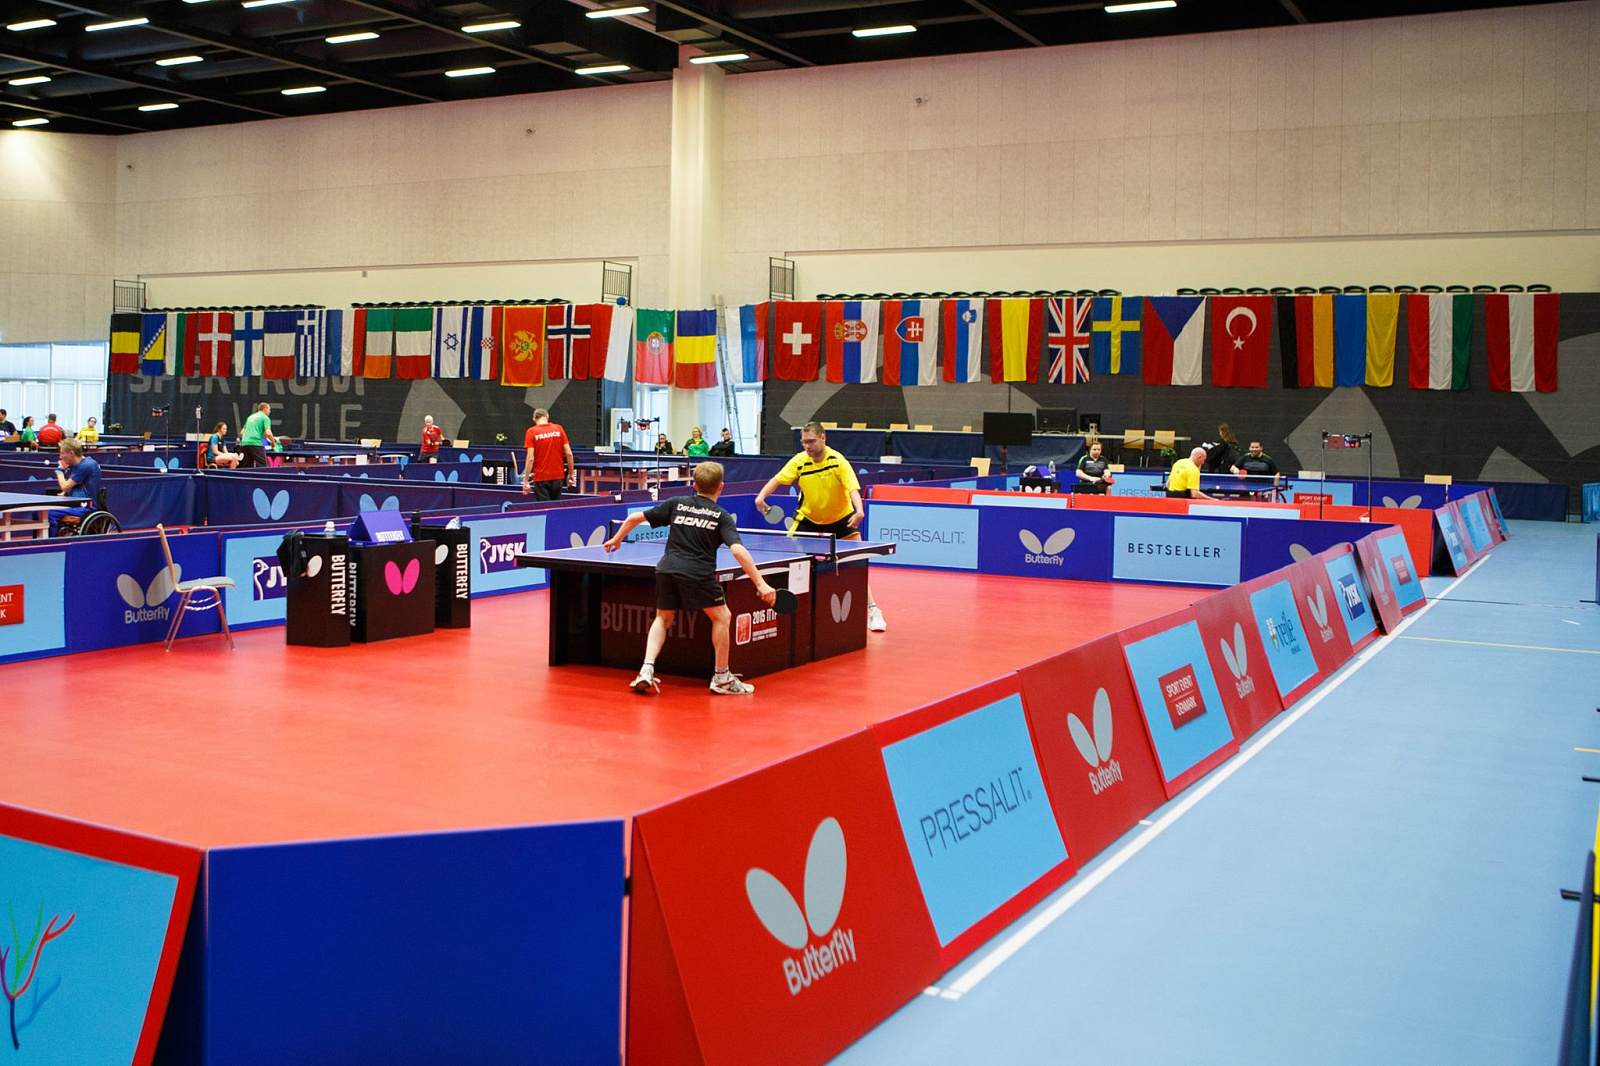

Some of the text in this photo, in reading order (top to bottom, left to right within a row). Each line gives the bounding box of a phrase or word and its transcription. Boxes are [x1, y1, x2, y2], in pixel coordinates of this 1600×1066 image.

[535, 431, 561, 441] FRANCE
[677, 503, 721, 519] Deutschland
[674, 516, 719, 530] DONIC
[1127, 542, 1221, 558] BESTSELLER
[1024, 553, 1065, 566] Butterfly
[455, 543, 468, 599] BUTTERFLY
[331, 554, 346, 615] BUTTERFLY
[124, 606, 170, 624] Butterfly
[1088, 759, 1123, 796] Butterfly
[782, 928, 857, 996] Butterfly
